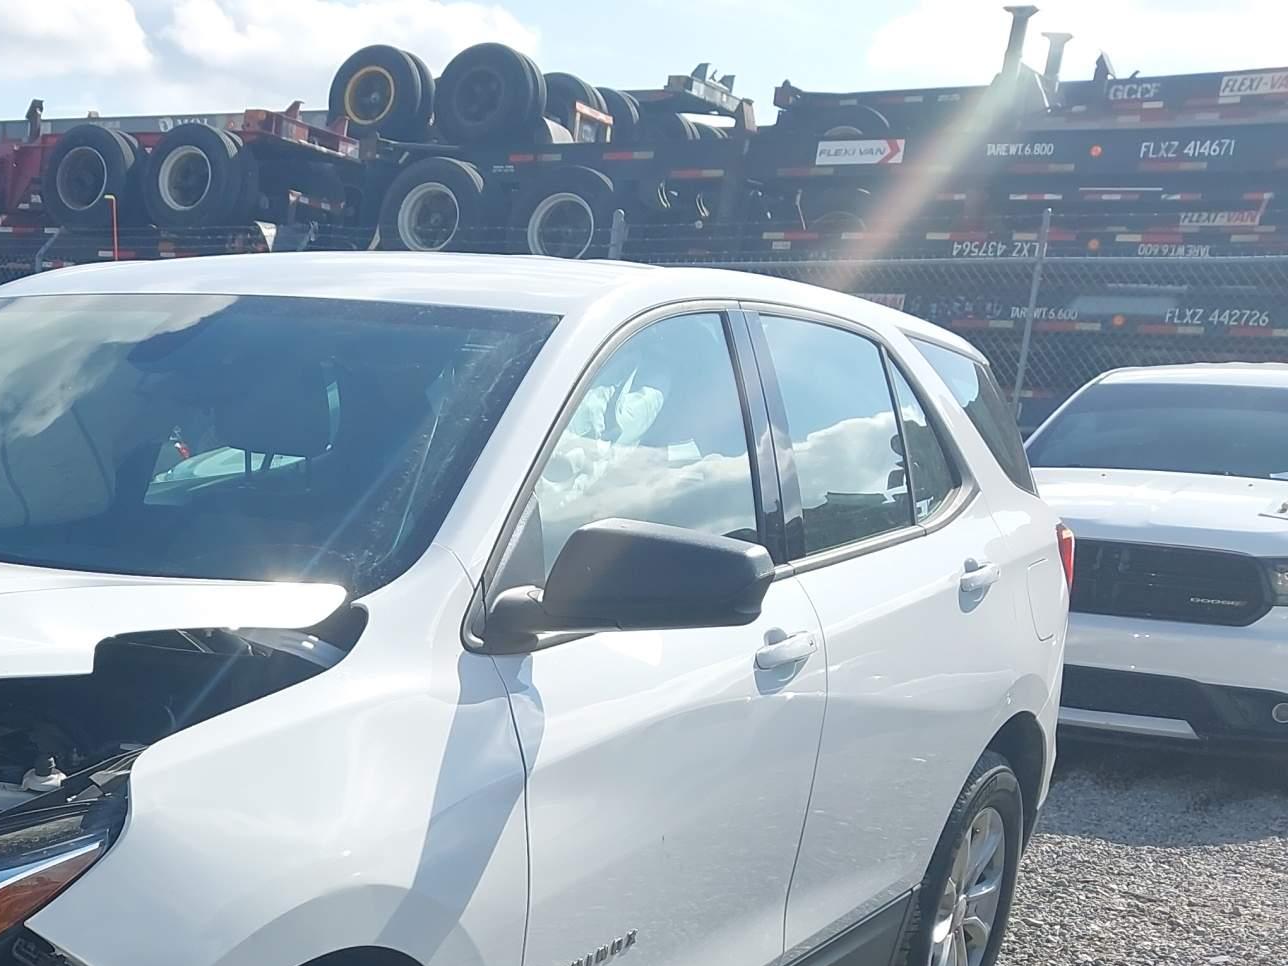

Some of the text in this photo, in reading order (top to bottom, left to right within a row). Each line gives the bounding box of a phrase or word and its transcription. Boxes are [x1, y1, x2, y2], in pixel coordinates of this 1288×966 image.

[1140, 139, 1236, 158] FLXZ 414671
[952, 241, 1007, 257] 437564
[1165, 308, 1270, 326] FLXZ 442726
[1190, 597, 1248, 607] DODGE
